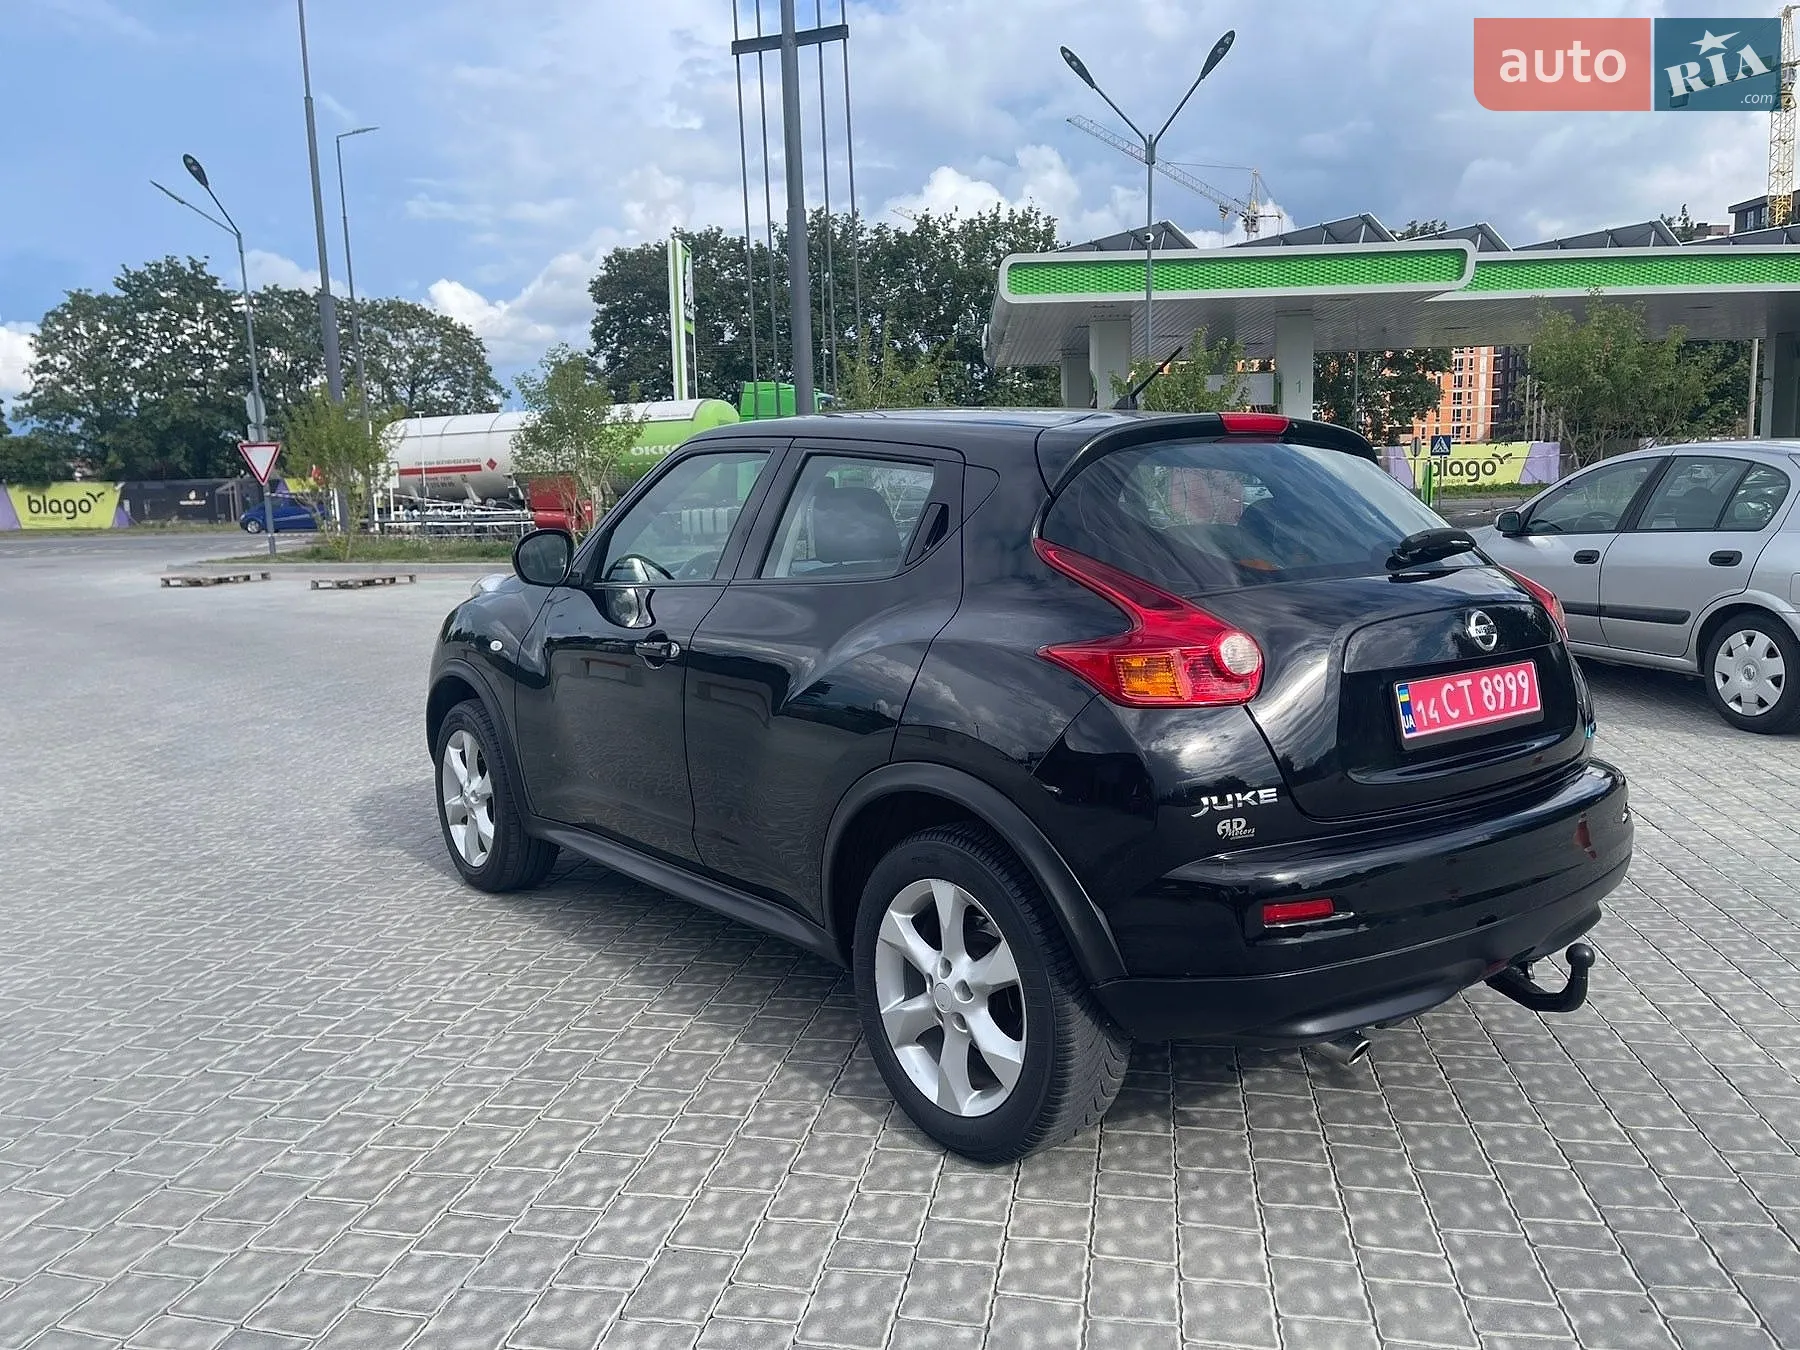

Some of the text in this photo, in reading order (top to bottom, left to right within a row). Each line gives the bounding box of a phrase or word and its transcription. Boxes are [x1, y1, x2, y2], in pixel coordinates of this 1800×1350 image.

[27, 494, 92, 520] blago
[1479, 669, 1530, 712] 8999
[1402, 714, 1416, 729] UA
[1190, 787, 1279, 818] JUKE
